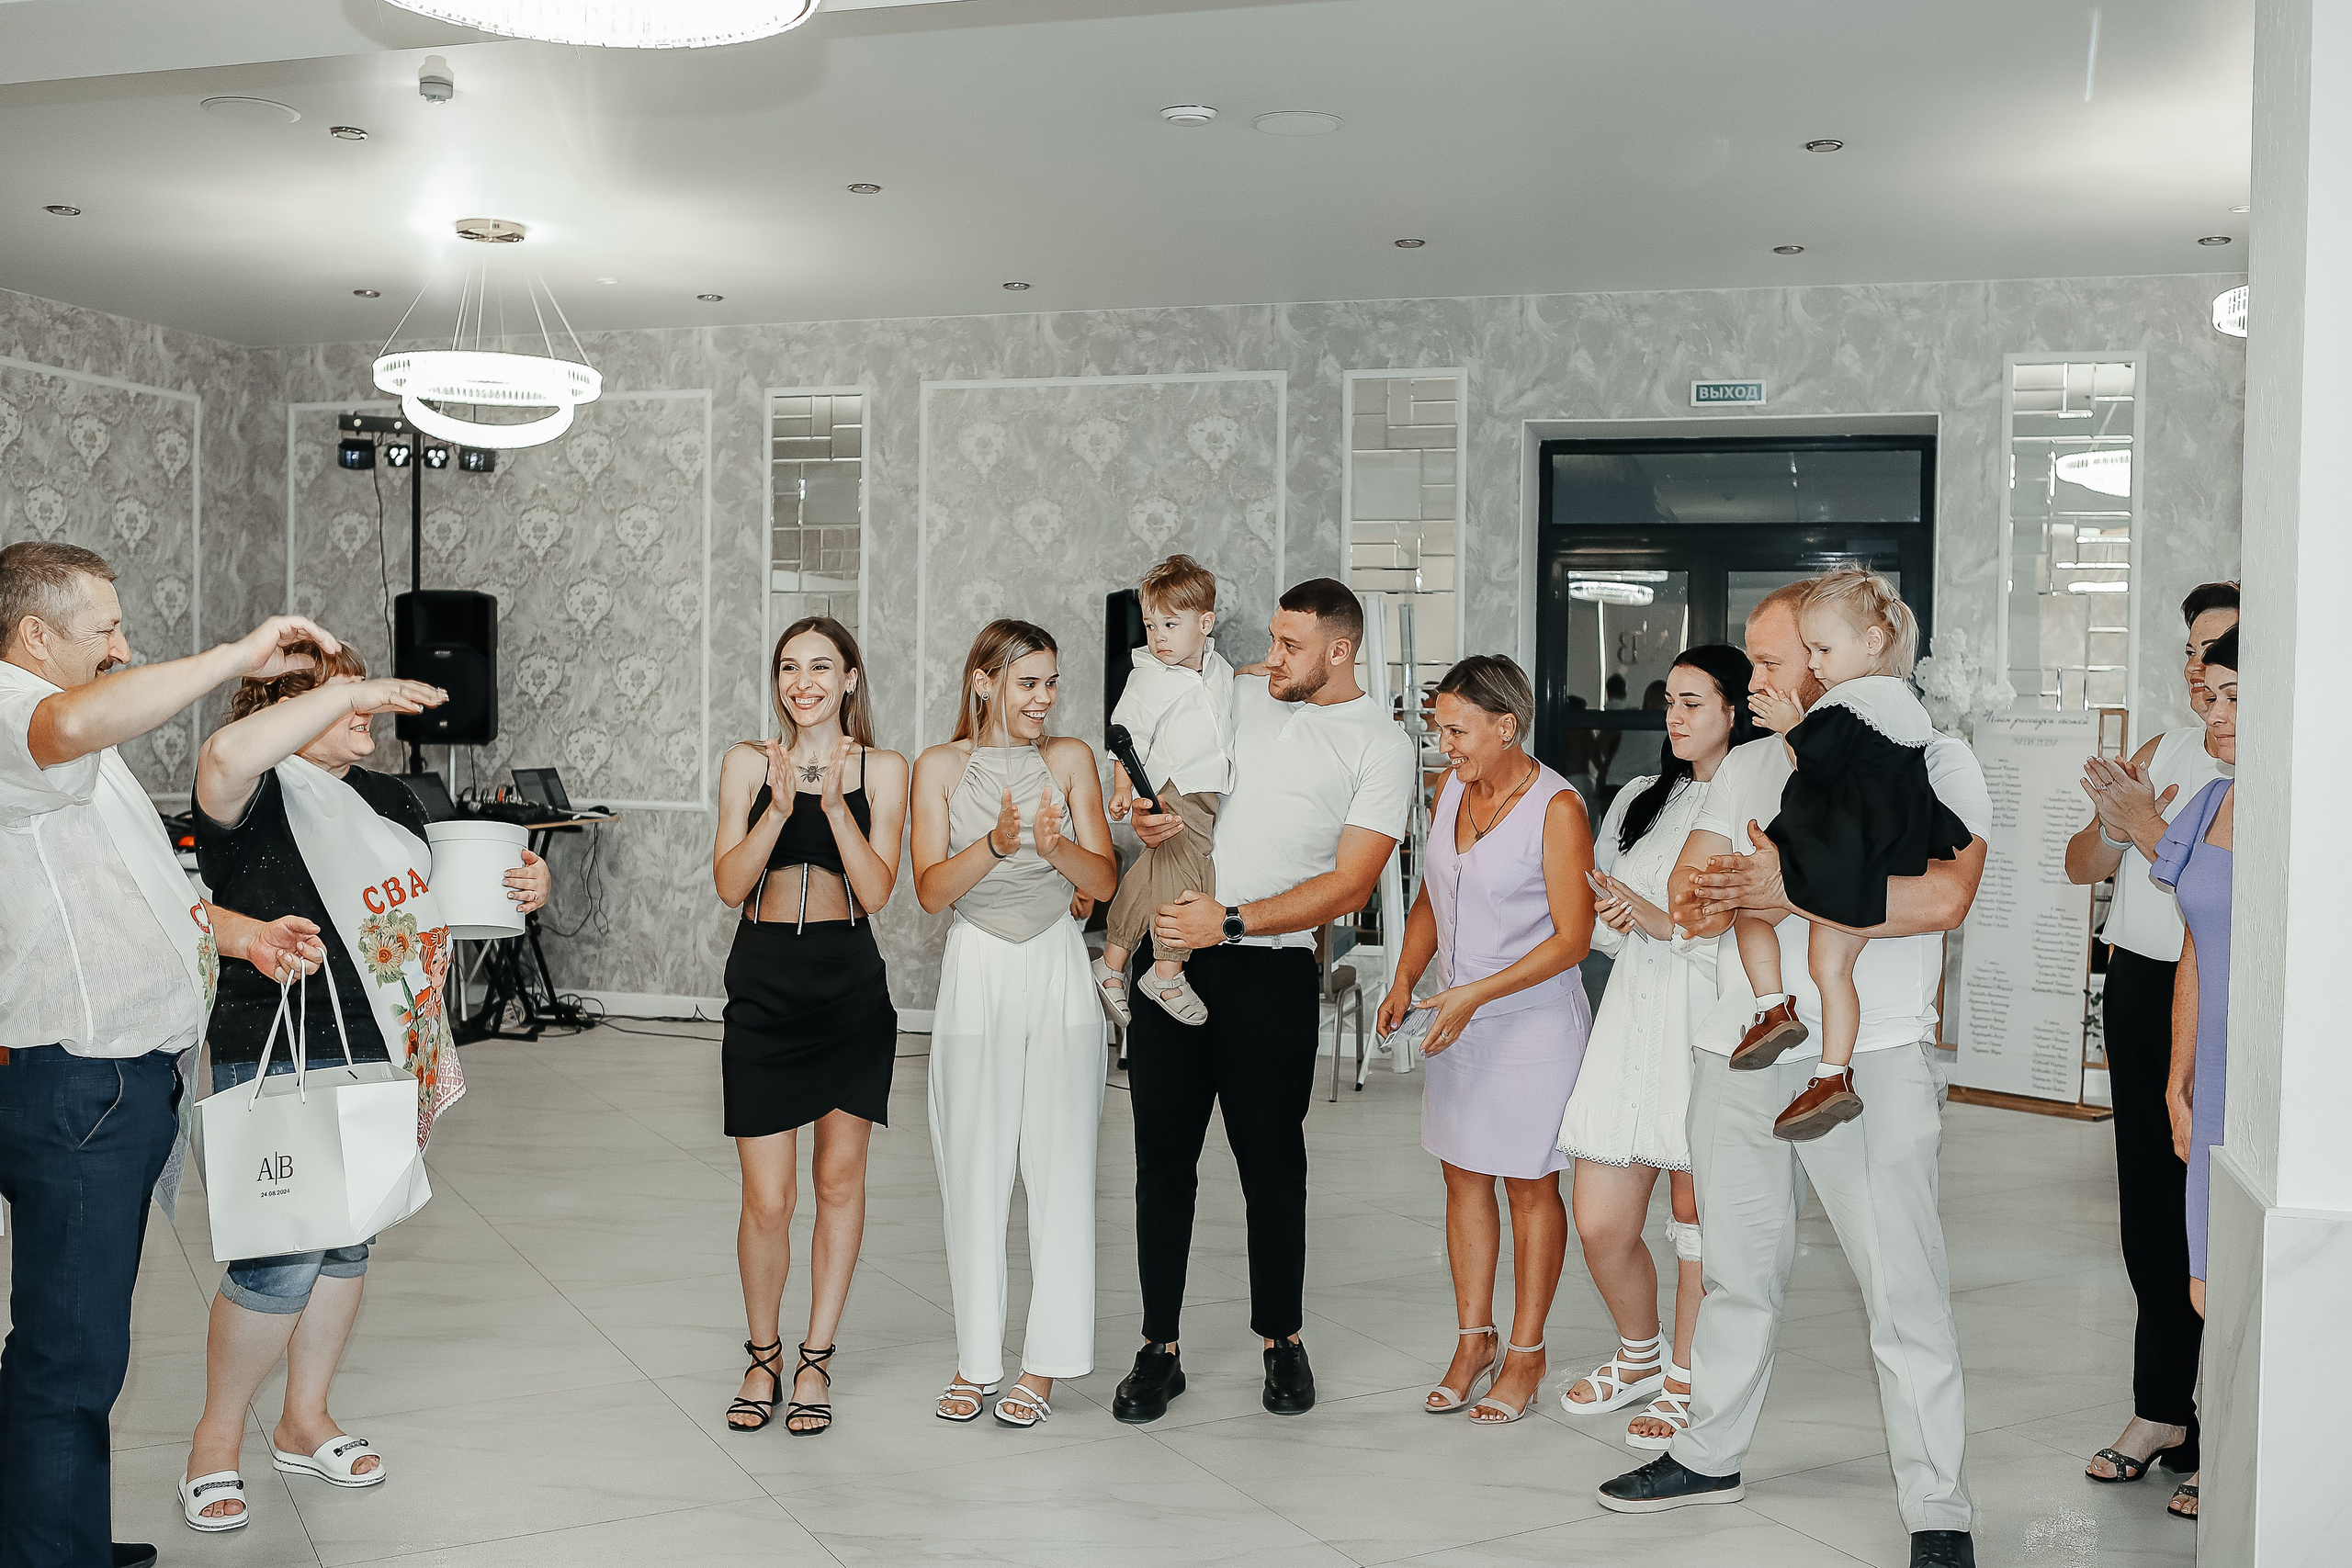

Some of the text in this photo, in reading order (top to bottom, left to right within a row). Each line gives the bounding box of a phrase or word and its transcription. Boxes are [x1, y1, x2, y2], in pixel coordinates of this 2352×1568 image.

[1699, 386, 1758, 400] ВЫХОД
[363, 867, 429, 914] СВА
[260, 1189, 290, 1198] 24.08.2024
